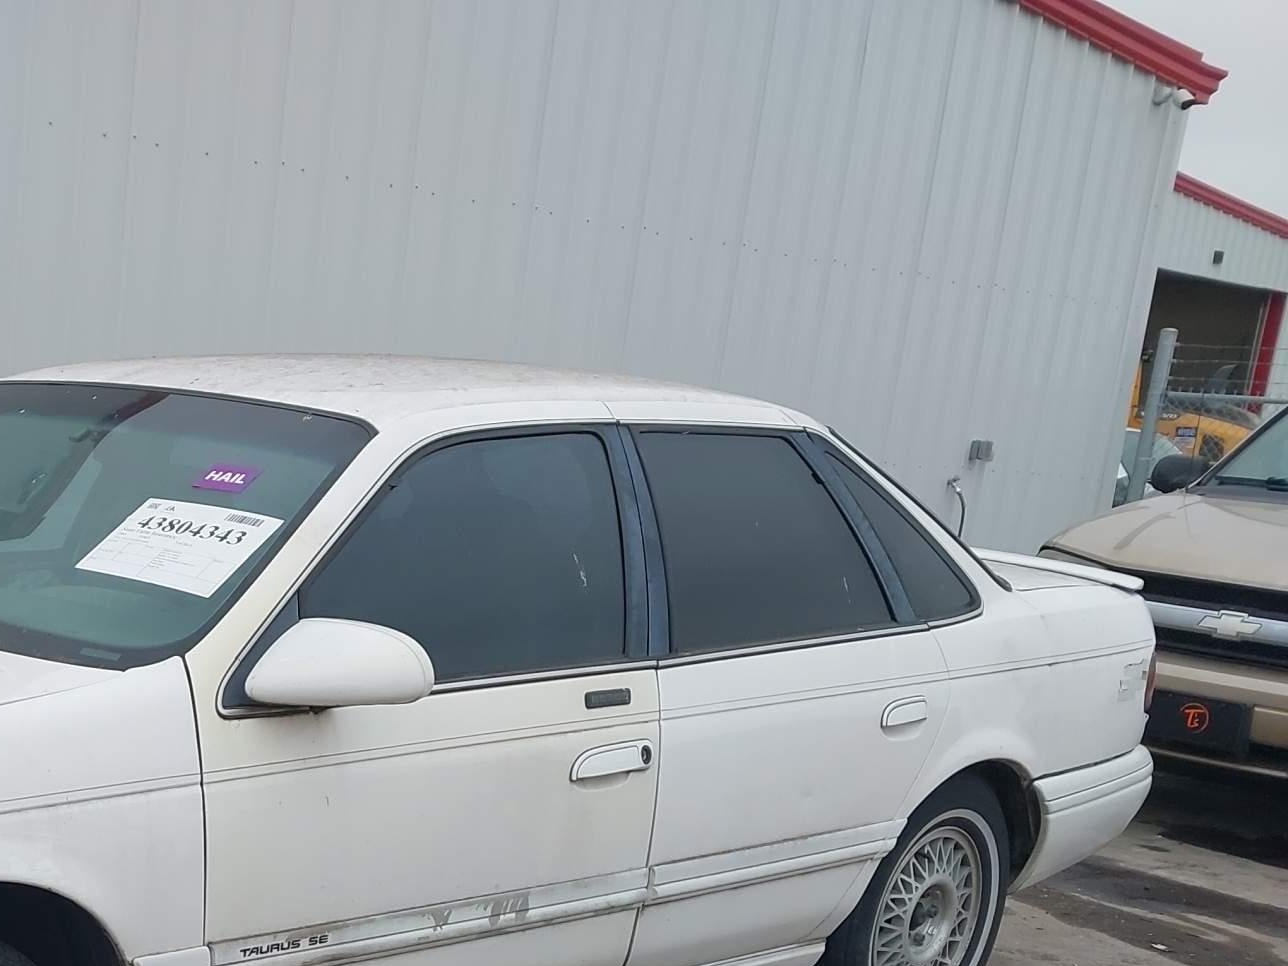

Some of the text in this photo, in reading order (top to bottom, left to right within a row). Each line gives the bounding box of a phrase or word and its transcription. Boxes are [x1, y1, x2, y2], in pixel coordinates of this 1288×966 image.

[205, 469, 246, 485] HAIL
[137, 515, 248, 546] 43804343
[240, 934, 329, 958] TAURUS SE
